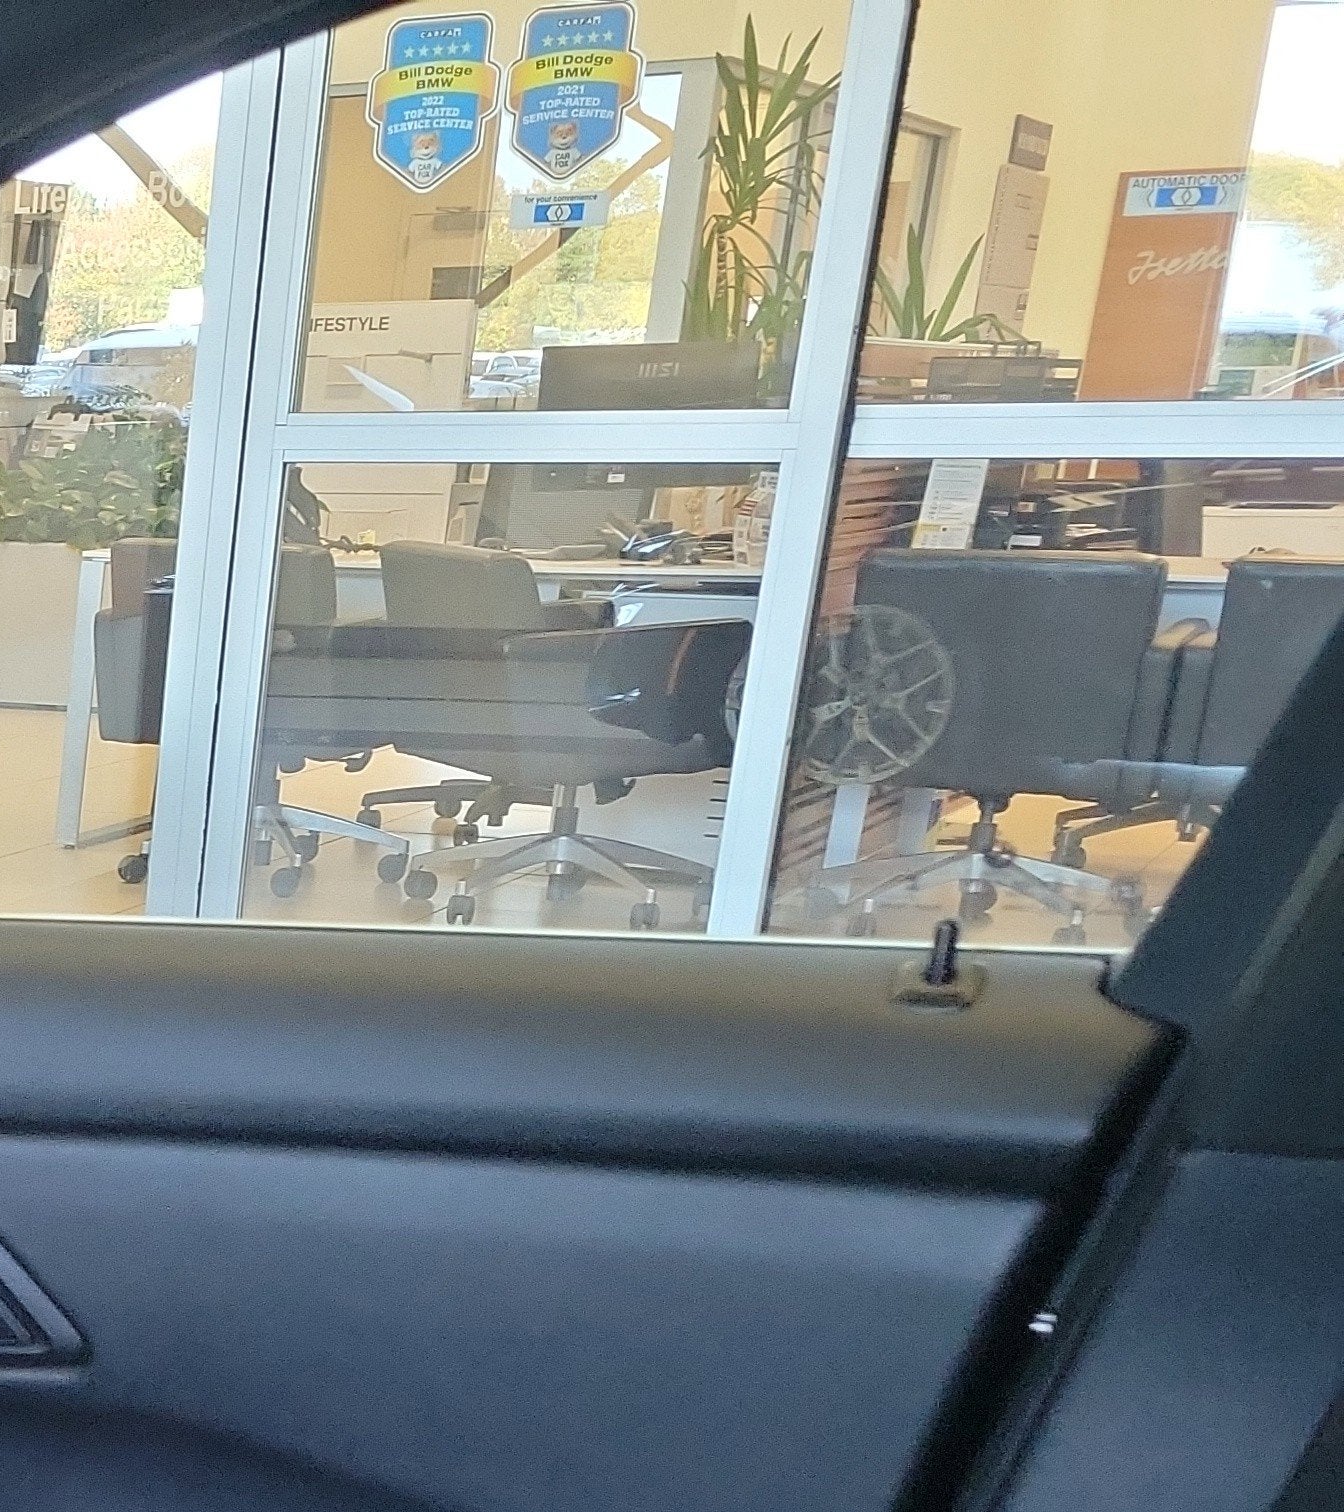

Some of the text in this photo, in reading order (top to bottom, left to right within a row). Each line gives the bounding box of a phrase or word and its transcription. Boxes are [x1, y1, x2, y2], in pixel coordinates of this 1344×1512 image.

[535, 53, 614, 70] Bill Dodge
[398, 65, 473, 81] Bill Dodge
[553, 66, 594, 79] BMW
[416, 77, 454, 90] BMW
[557, 84, 585, 96] 2021
[421, 95, 444, 106] 2022
[539, 97, 601, 110] TOP-RATED
[403, 107, 461, 120] TOP-RATED
[522, 108, 615, 125] SERVICE CENTER
[387, 118, 474, 135] SERVICE CENTER
[555, 152, 570, 160] CAR
[417, 163, 432, 171] CAR
[418, 170, 431, 178] FOX
[1132, 175, 1209, 189] AUTOMATIC
[525, 195, 535, 204] for
[536, 196, 552, 204] your
[310, 315, 390, 333] IFESTYLE
